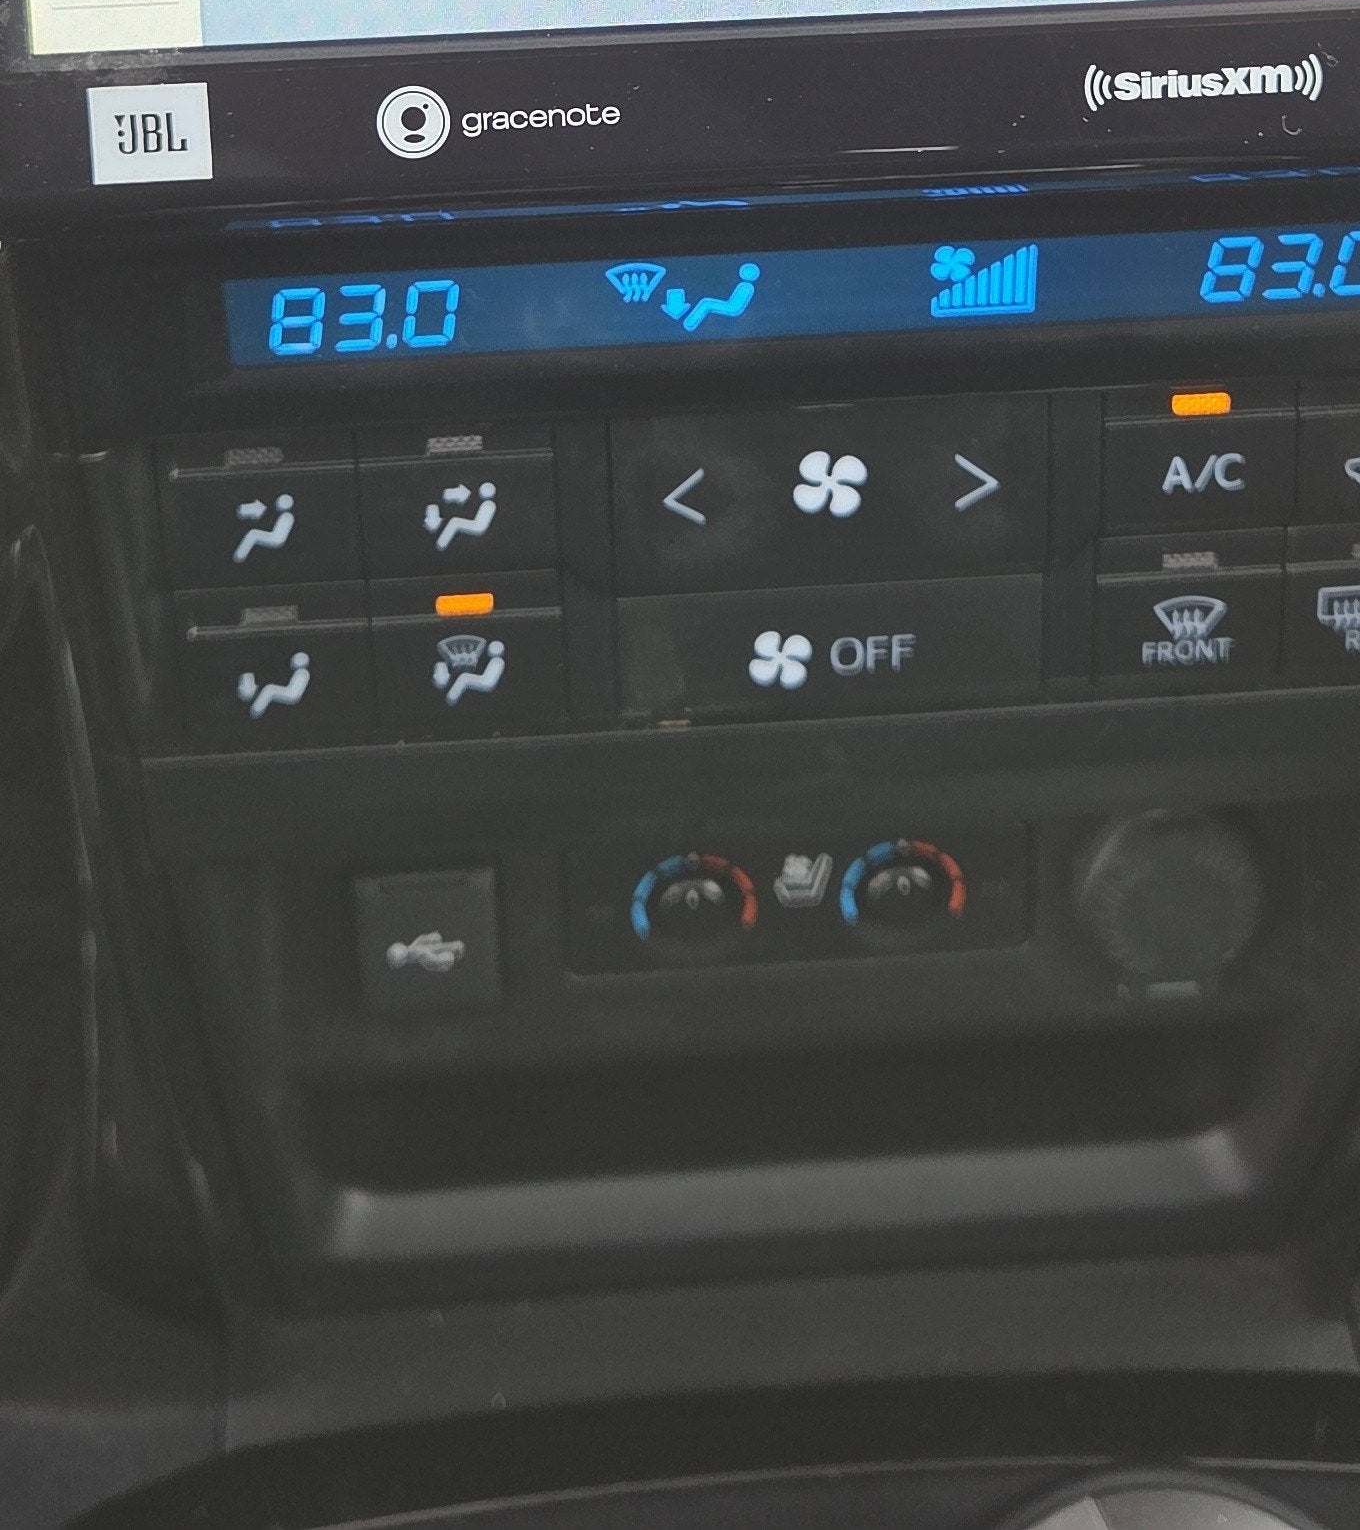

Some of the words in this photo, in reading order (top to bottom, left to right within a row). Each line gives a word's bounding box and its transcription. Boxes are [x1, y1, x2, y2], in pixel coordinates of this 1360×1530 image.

[117, 112, 189, 155] JBL
[461, 103, 621, 138] gracenote
[268, 278, 460, 356] 83.0
[1162, 453, 1245, 494] A/C
[830, 633, 917, 677] OFF
[1142, 637, 1235, 664] FRONT
